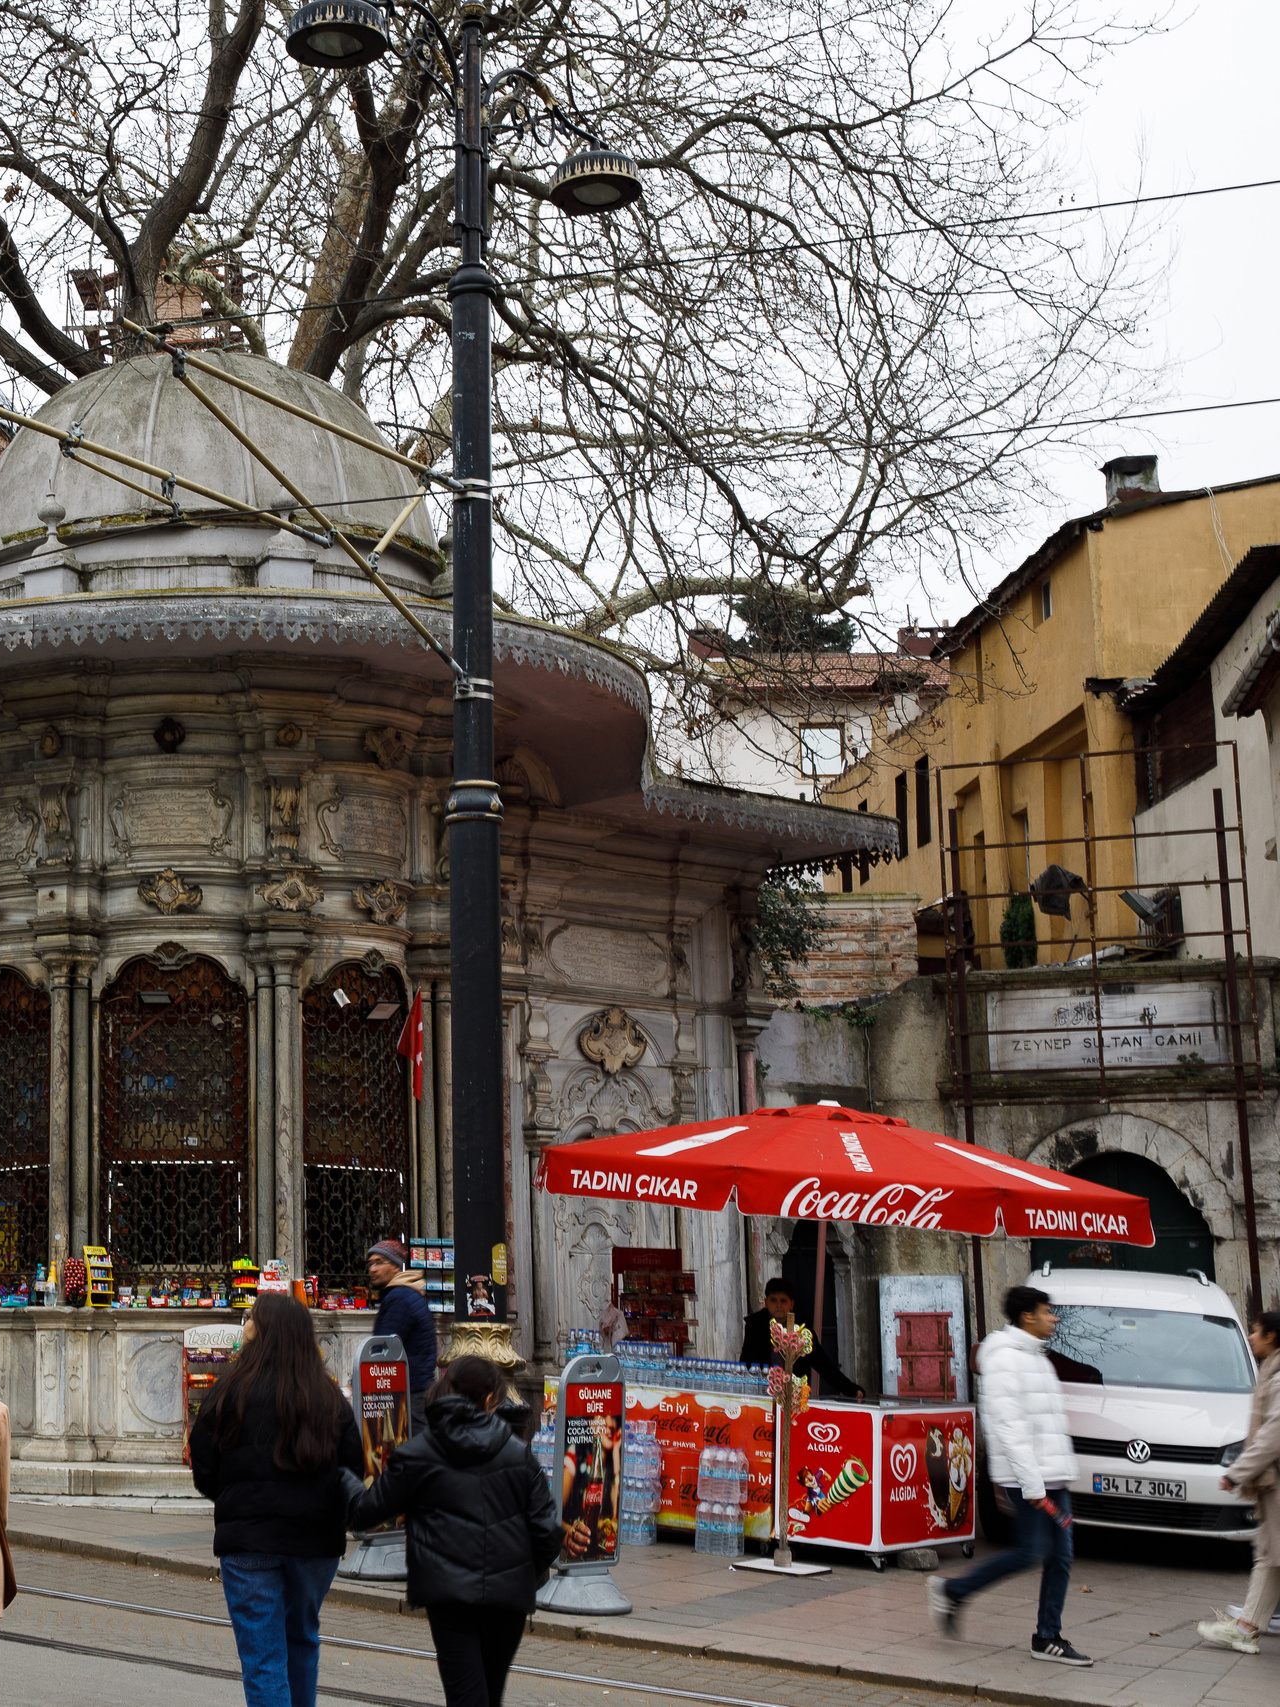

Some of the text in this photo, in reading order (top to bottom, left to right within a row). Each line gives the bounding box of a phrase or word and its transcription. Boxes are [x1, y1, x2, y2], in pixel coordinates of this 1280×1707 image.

[1011, 1038, 1071, 1051] ZEYNEP
[1083, 1035, 1142, 1049] SULTAN
[839, 1132, 865, 1154] TADINI
[570, 1169, 632, 1193] TADINI
[635, 1174, 698, 1201] ÇIKAR
[780, 1176, 955, 1229] Coca-Cola
[1025, 1208, 1129, 1236] TADINI ÇIKAR
[188, 1329, 243, 1346] tadel
[369, 1365, 397, 1376] GÜLHANE
[376, 1377, 391, 1389] BÜFE
[578, 1387, 612, 1400] GÜLHANE
[586, 1400, 604, 1413] BÜFE
[659, 1402, 689, 1416] En iyi
[566, 1436, 594, 1444] UNUTMA!
[672, 1441, 696, 1449] #HAYIR
[1102, 1477, 1119, 1492] 34
[1125, 1479, 1142, 1494] LZ
[1148, 1481, 1183, 1498] 3042
